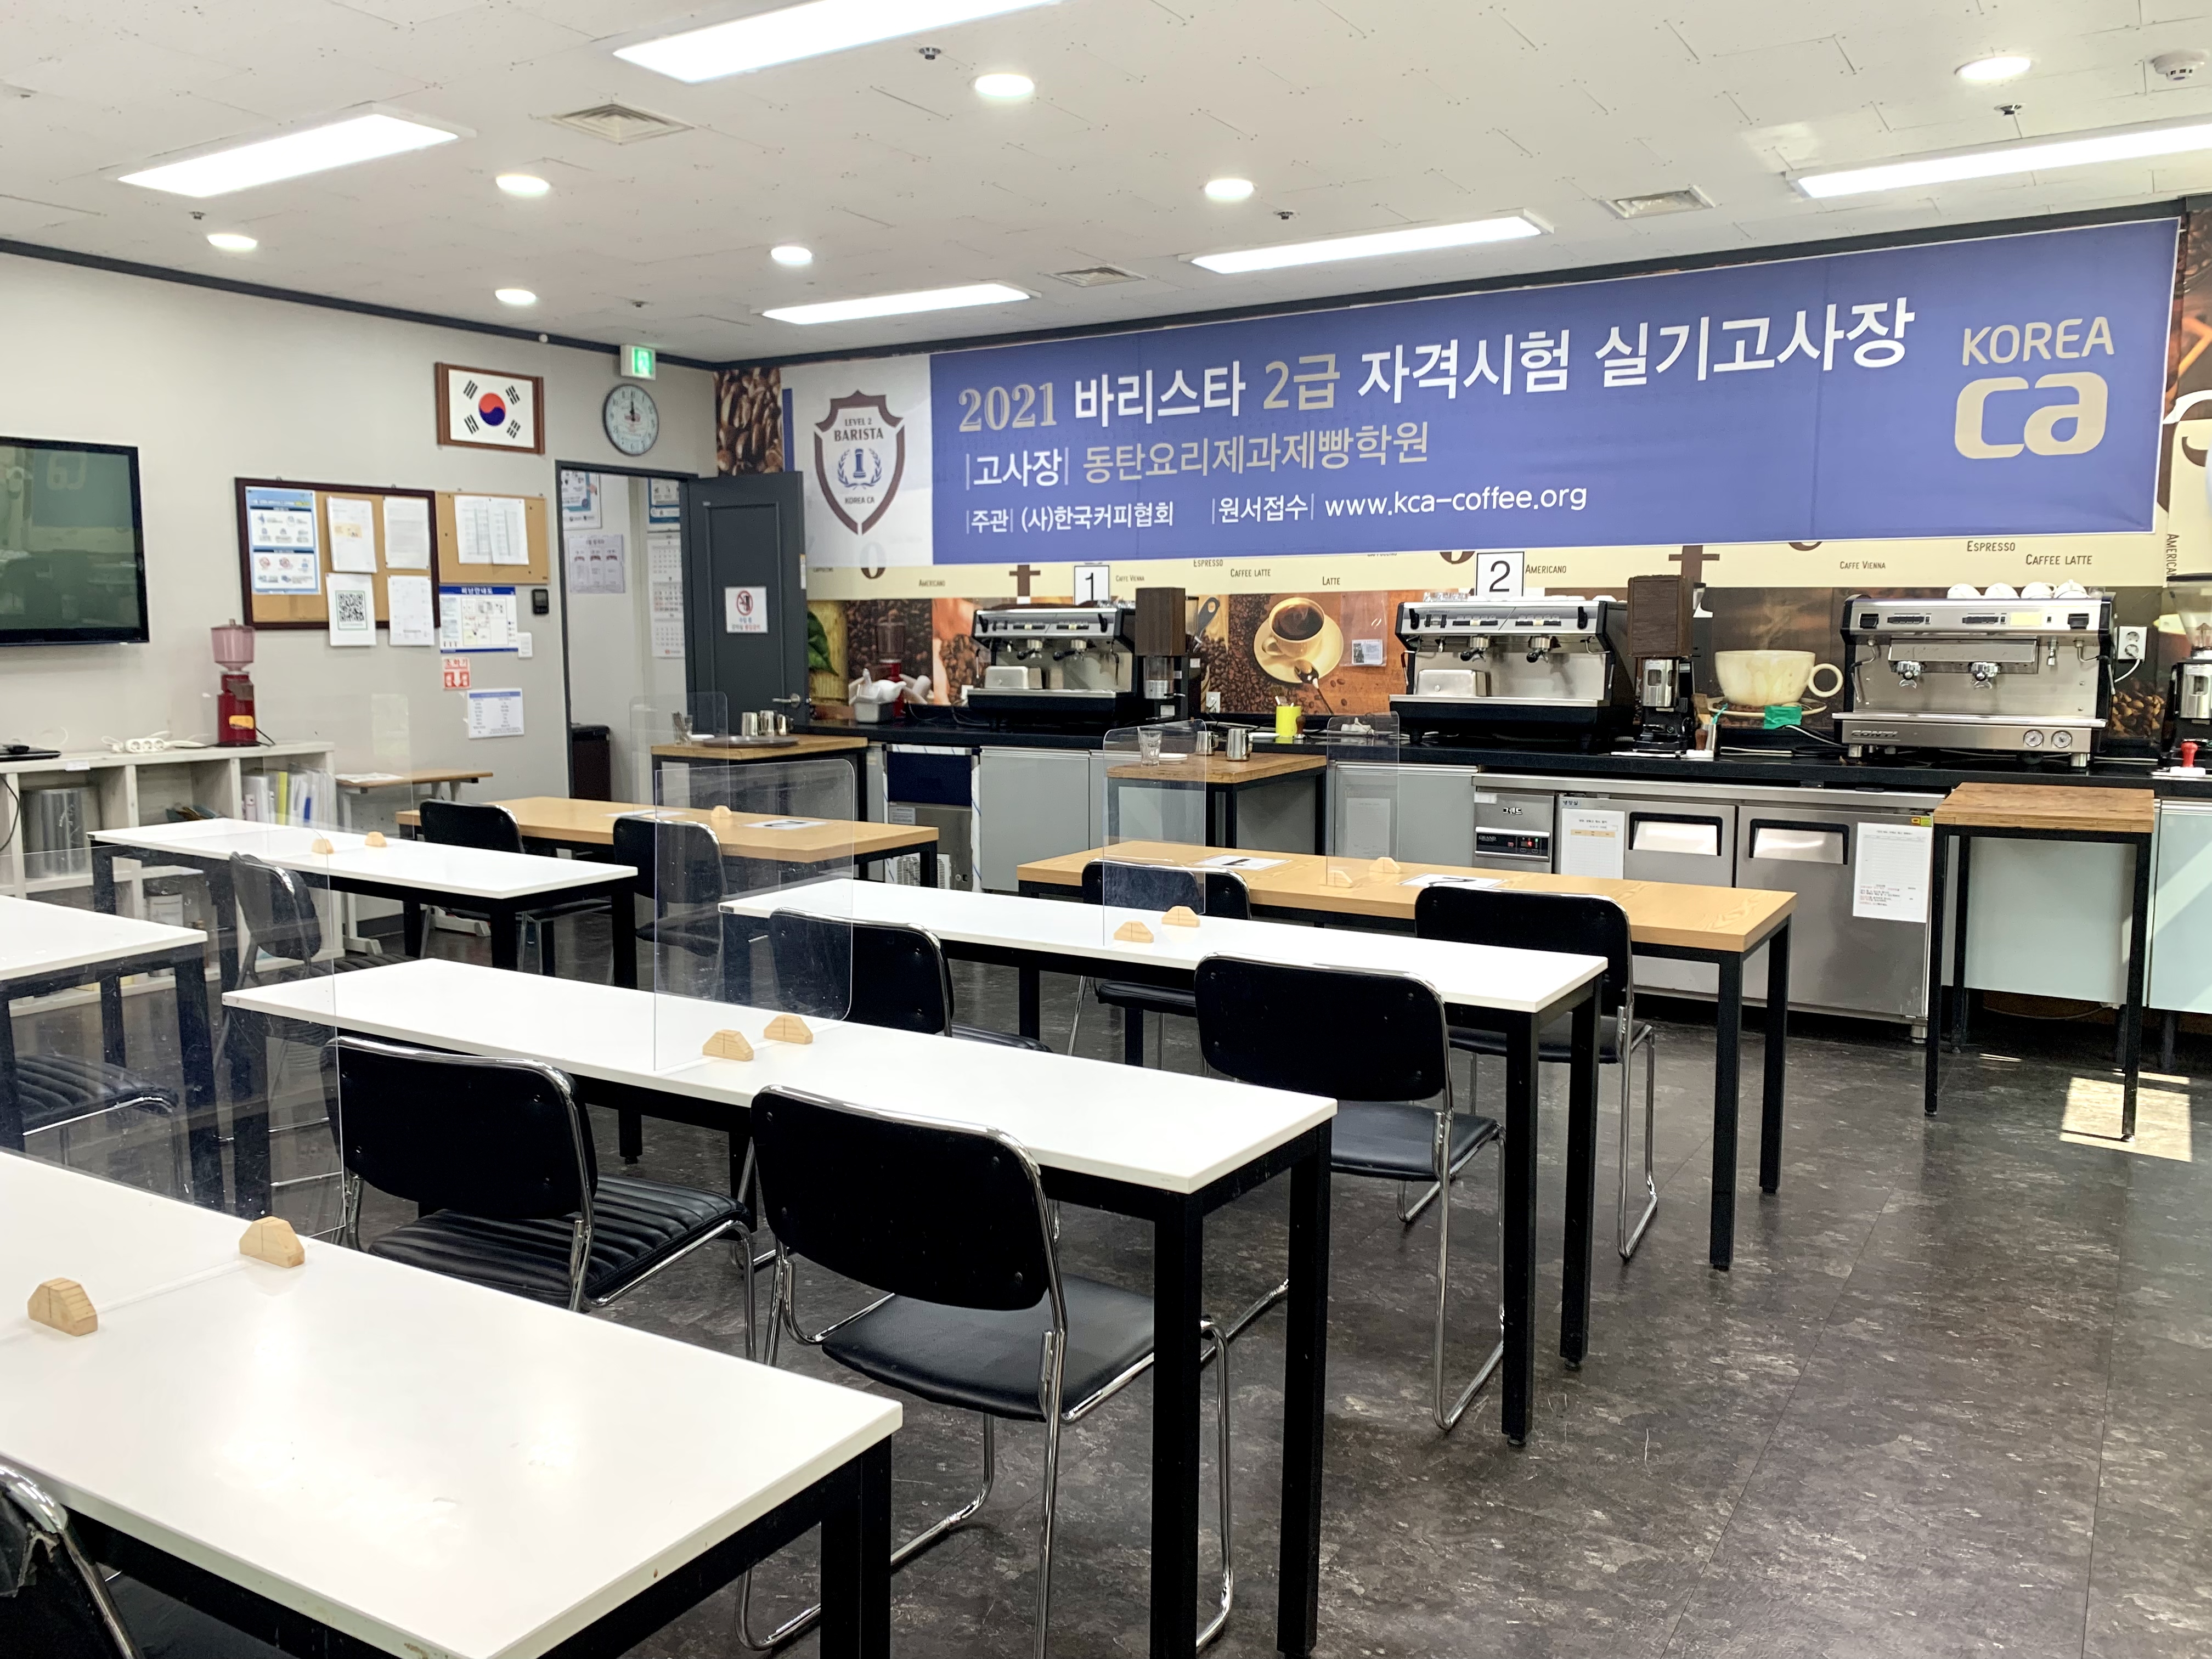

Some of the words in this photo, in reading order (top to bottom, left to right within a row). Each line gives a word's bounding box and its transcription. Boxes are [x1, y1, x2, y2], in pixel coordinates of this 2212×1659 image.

[1962, 317, 2115, 366] KOREA
[960, 382, 1057, 432] 2021
[1075, 361, 1246, 427] 바리스타
[1263, 353, 1341, 411] 2급
[1357, 329, 1570, 404] 자격시험
[1595, 297, 1916, 387] 실기고사장
[1954, 371, 2108, 459] ca
[845, 418, 865, 427] LEVEL
[834, 428, 884, 442] BARISTA
[1083, 420, 1428, 484] 동탄요리제과제빵학원
[1021, 500, 1173, 534] (사)한국커피협회
[1325, 486, 1587, 516] www.kca-coffee.org
[1967, 540, 2016, 552] ESPRESSO
[1193, 558, 1223, 567] ESPRESSO
[1839, 561, 1860, 569] CAFFE
[1862, 561, 1886, 569] VIENNA
[2025, 554, 2061, 566] CAFFEE
[2065, 555, 2093, 565] LATTE
[1231, 568, 1252, 578] CAFFEE
[1254, 568, 1271, 577] LATTE
[1525, 564, 1567, 574] AMERICANO
[1322, 576, 1341, 586] LATTE
[1489, 560, 1511, 593] 2
[919, 579, 946, 588] AMERICANO
[1085, 572, 1093, 601] 1
[1851, 730, 1899, 738] CONTI
